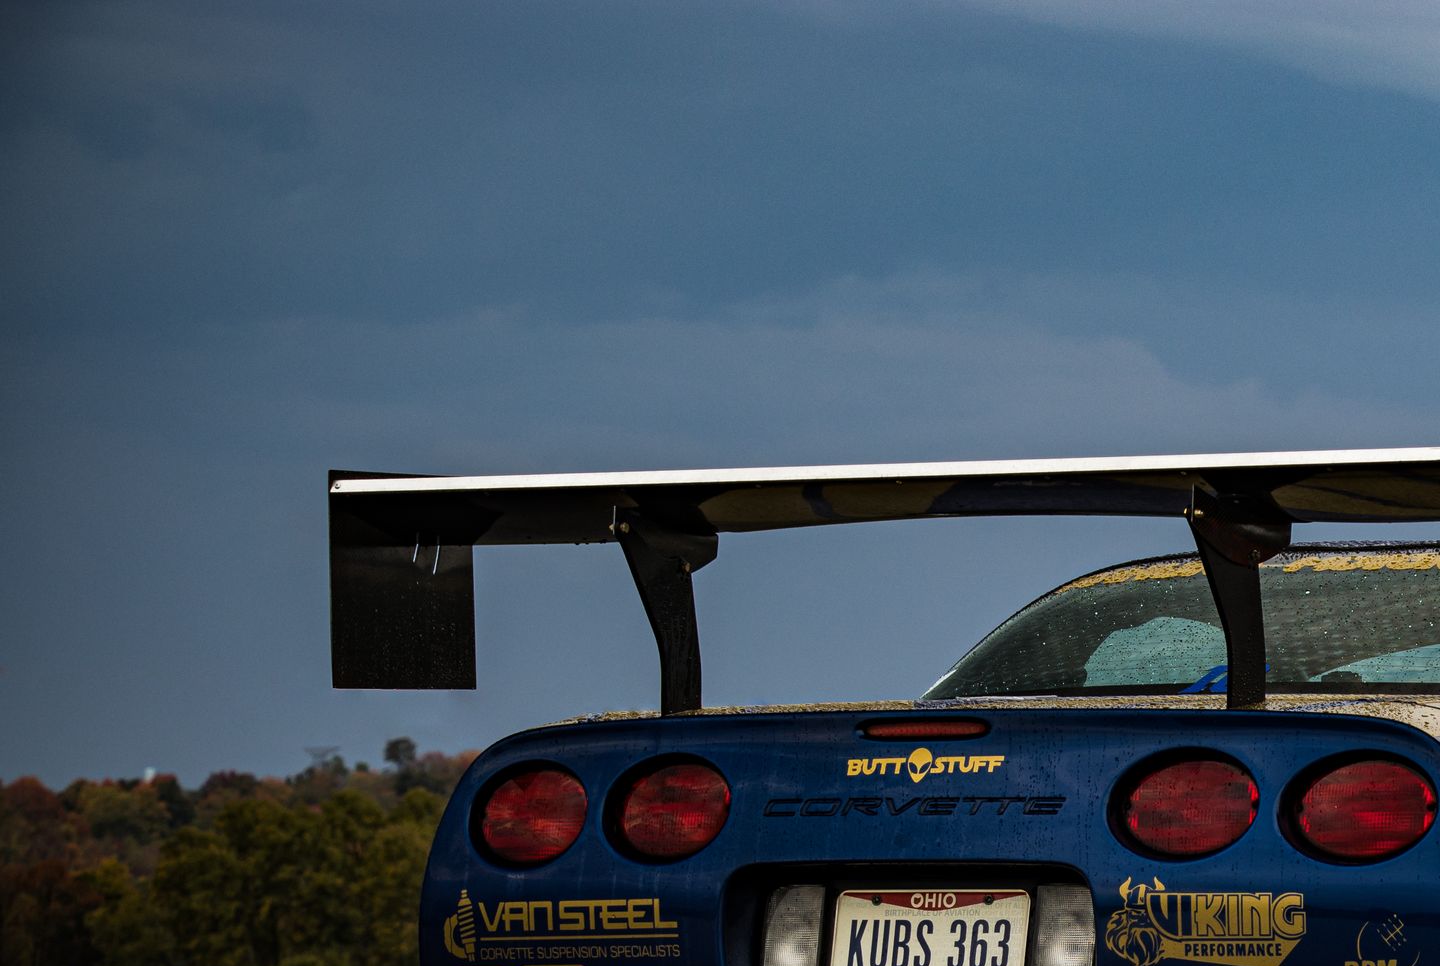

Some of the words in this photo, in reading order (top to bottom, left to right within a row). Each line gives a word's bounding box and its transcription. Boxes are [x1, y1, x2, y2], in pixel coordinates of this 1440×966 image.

[846, 758, 906, 776] BUTT
[929, 755, 1005, 774] STUFF
[763, 796, 1067, 817] CORVETTE
[911, 892, 957, 908] OHIO
[884, 909, 931, 917] BIRTHPLACE
[1145, 891, 1307, 942] VIKING
[480, 946, 534, 960] CORVETTE
[536, 945, 608, 960] SUSPENSION
[610, 943, 681, 958] SPECIALISTS
[1184, 943, 1282, 957] PERFORMANCE
